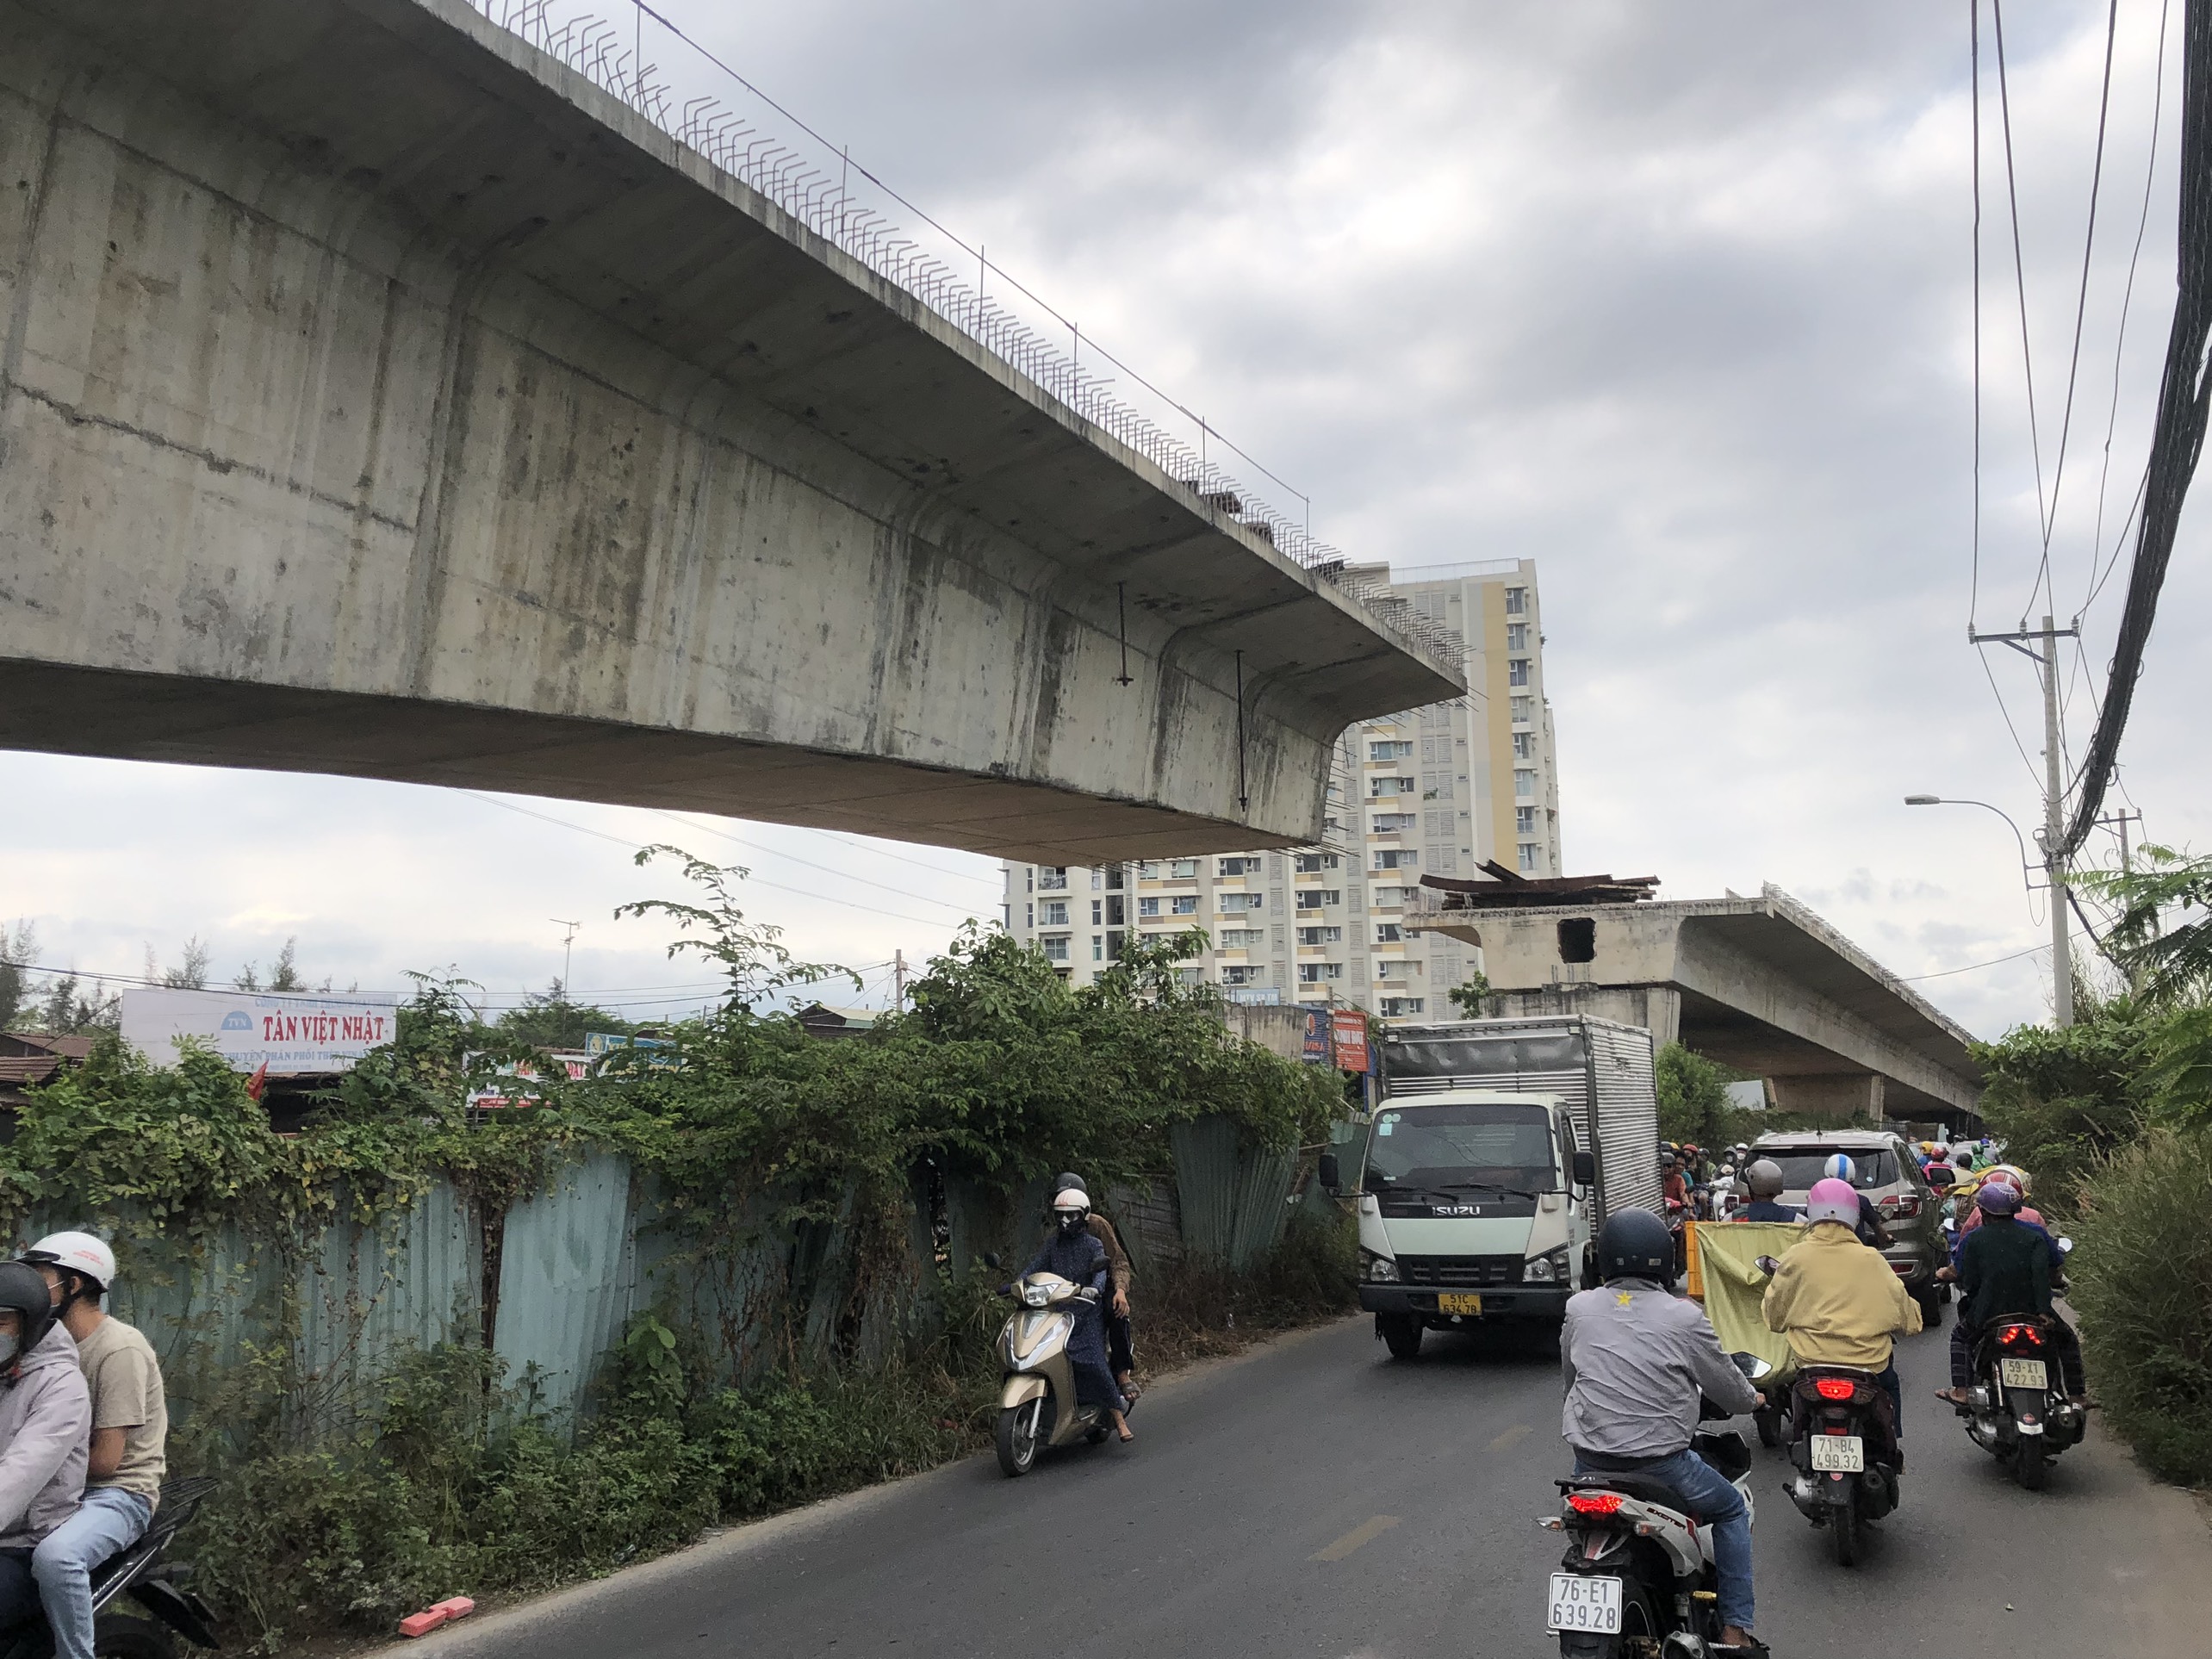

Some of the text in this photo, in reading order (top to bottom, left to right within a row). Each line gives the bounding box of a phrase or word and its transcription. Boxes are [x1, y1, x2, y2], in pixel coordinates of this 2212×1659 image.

[228, 1017, 247, 1028] TVN
[263, 1009, 384, 1045] TÂN VIỆT NHẬT
[1432, 1206, 1481, 1215] ISUZU
[1450, 1295, 1469, 1304] 51C
[1819, 1438, 1855, 1453] 71-B4
[1817, 1454, 1859, 1469] 499.32
[1561, 1579, 1607, 1604] 76-E1
[1552, 1603, 1616, 1630] 639.28
